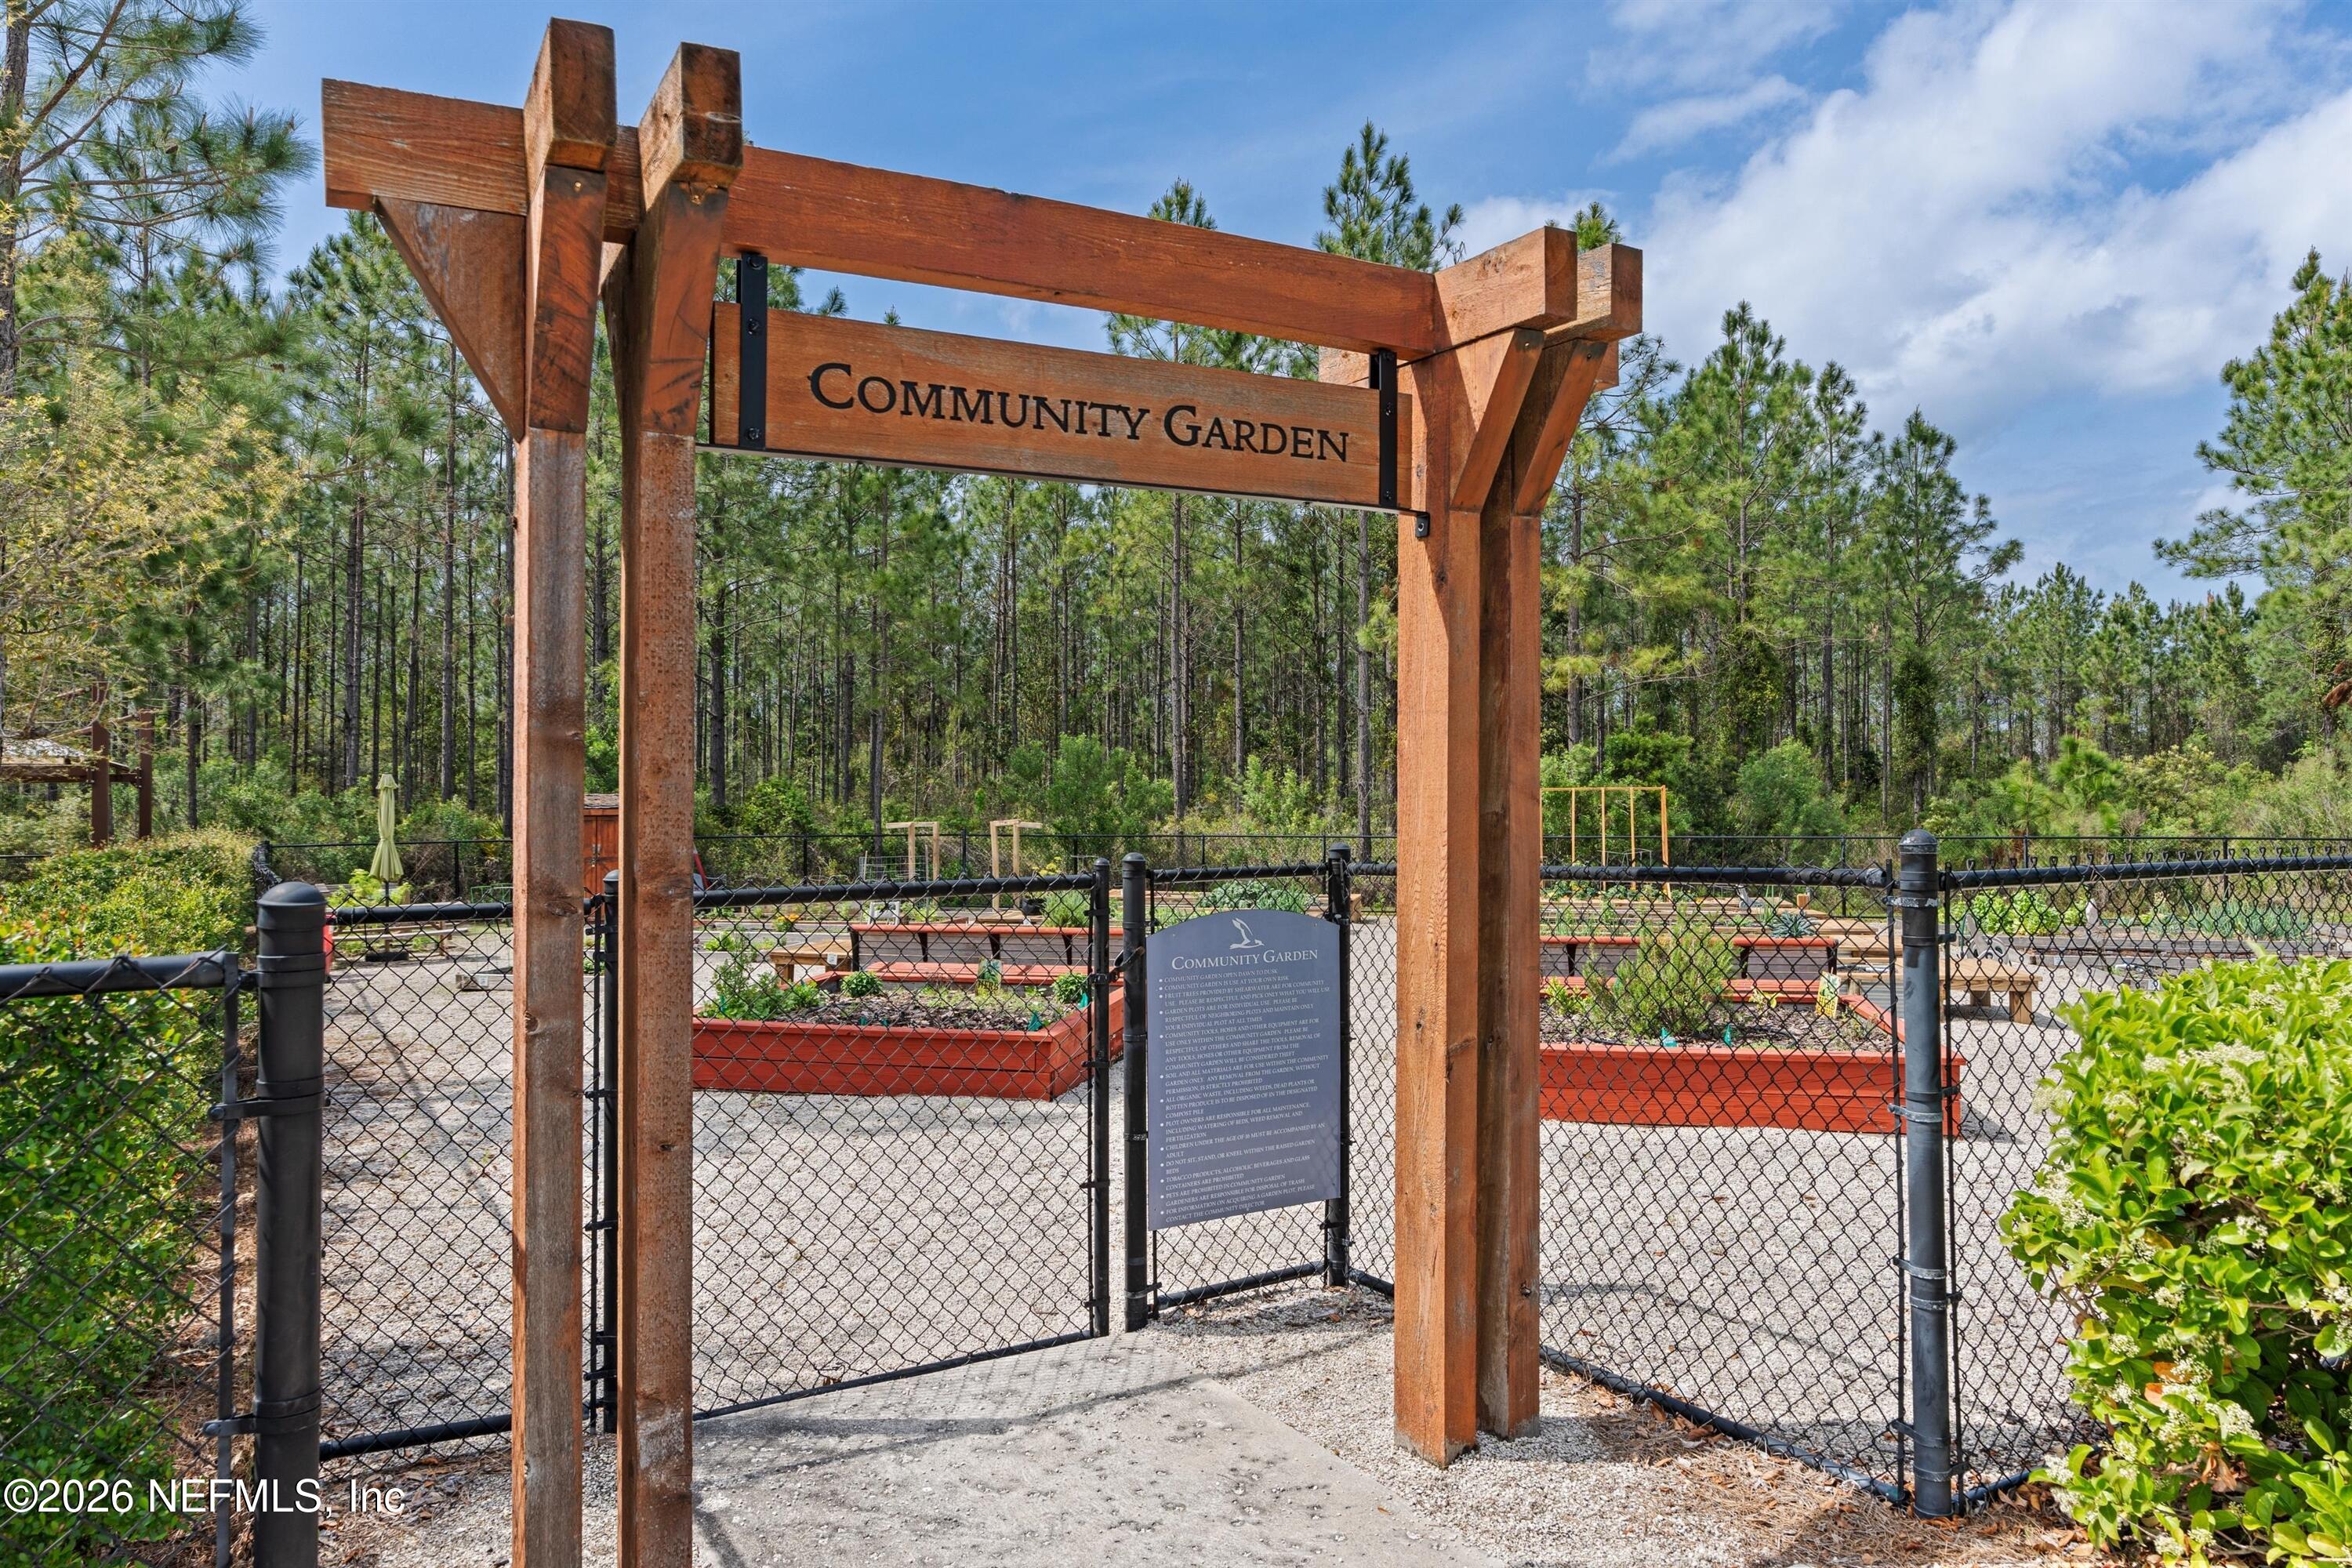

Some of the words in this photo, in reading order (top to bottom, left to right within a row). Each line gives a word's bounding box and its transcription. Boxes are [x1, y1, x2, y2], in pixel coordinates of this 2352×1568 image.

[808, 362, 1150, 441] COMMUNITY
[1163, 405, 1350, 463] GARDEN
[1172, 955, 1260, 970] COMMUNITY
[1263, 949, 1318, 964] GARDEN
